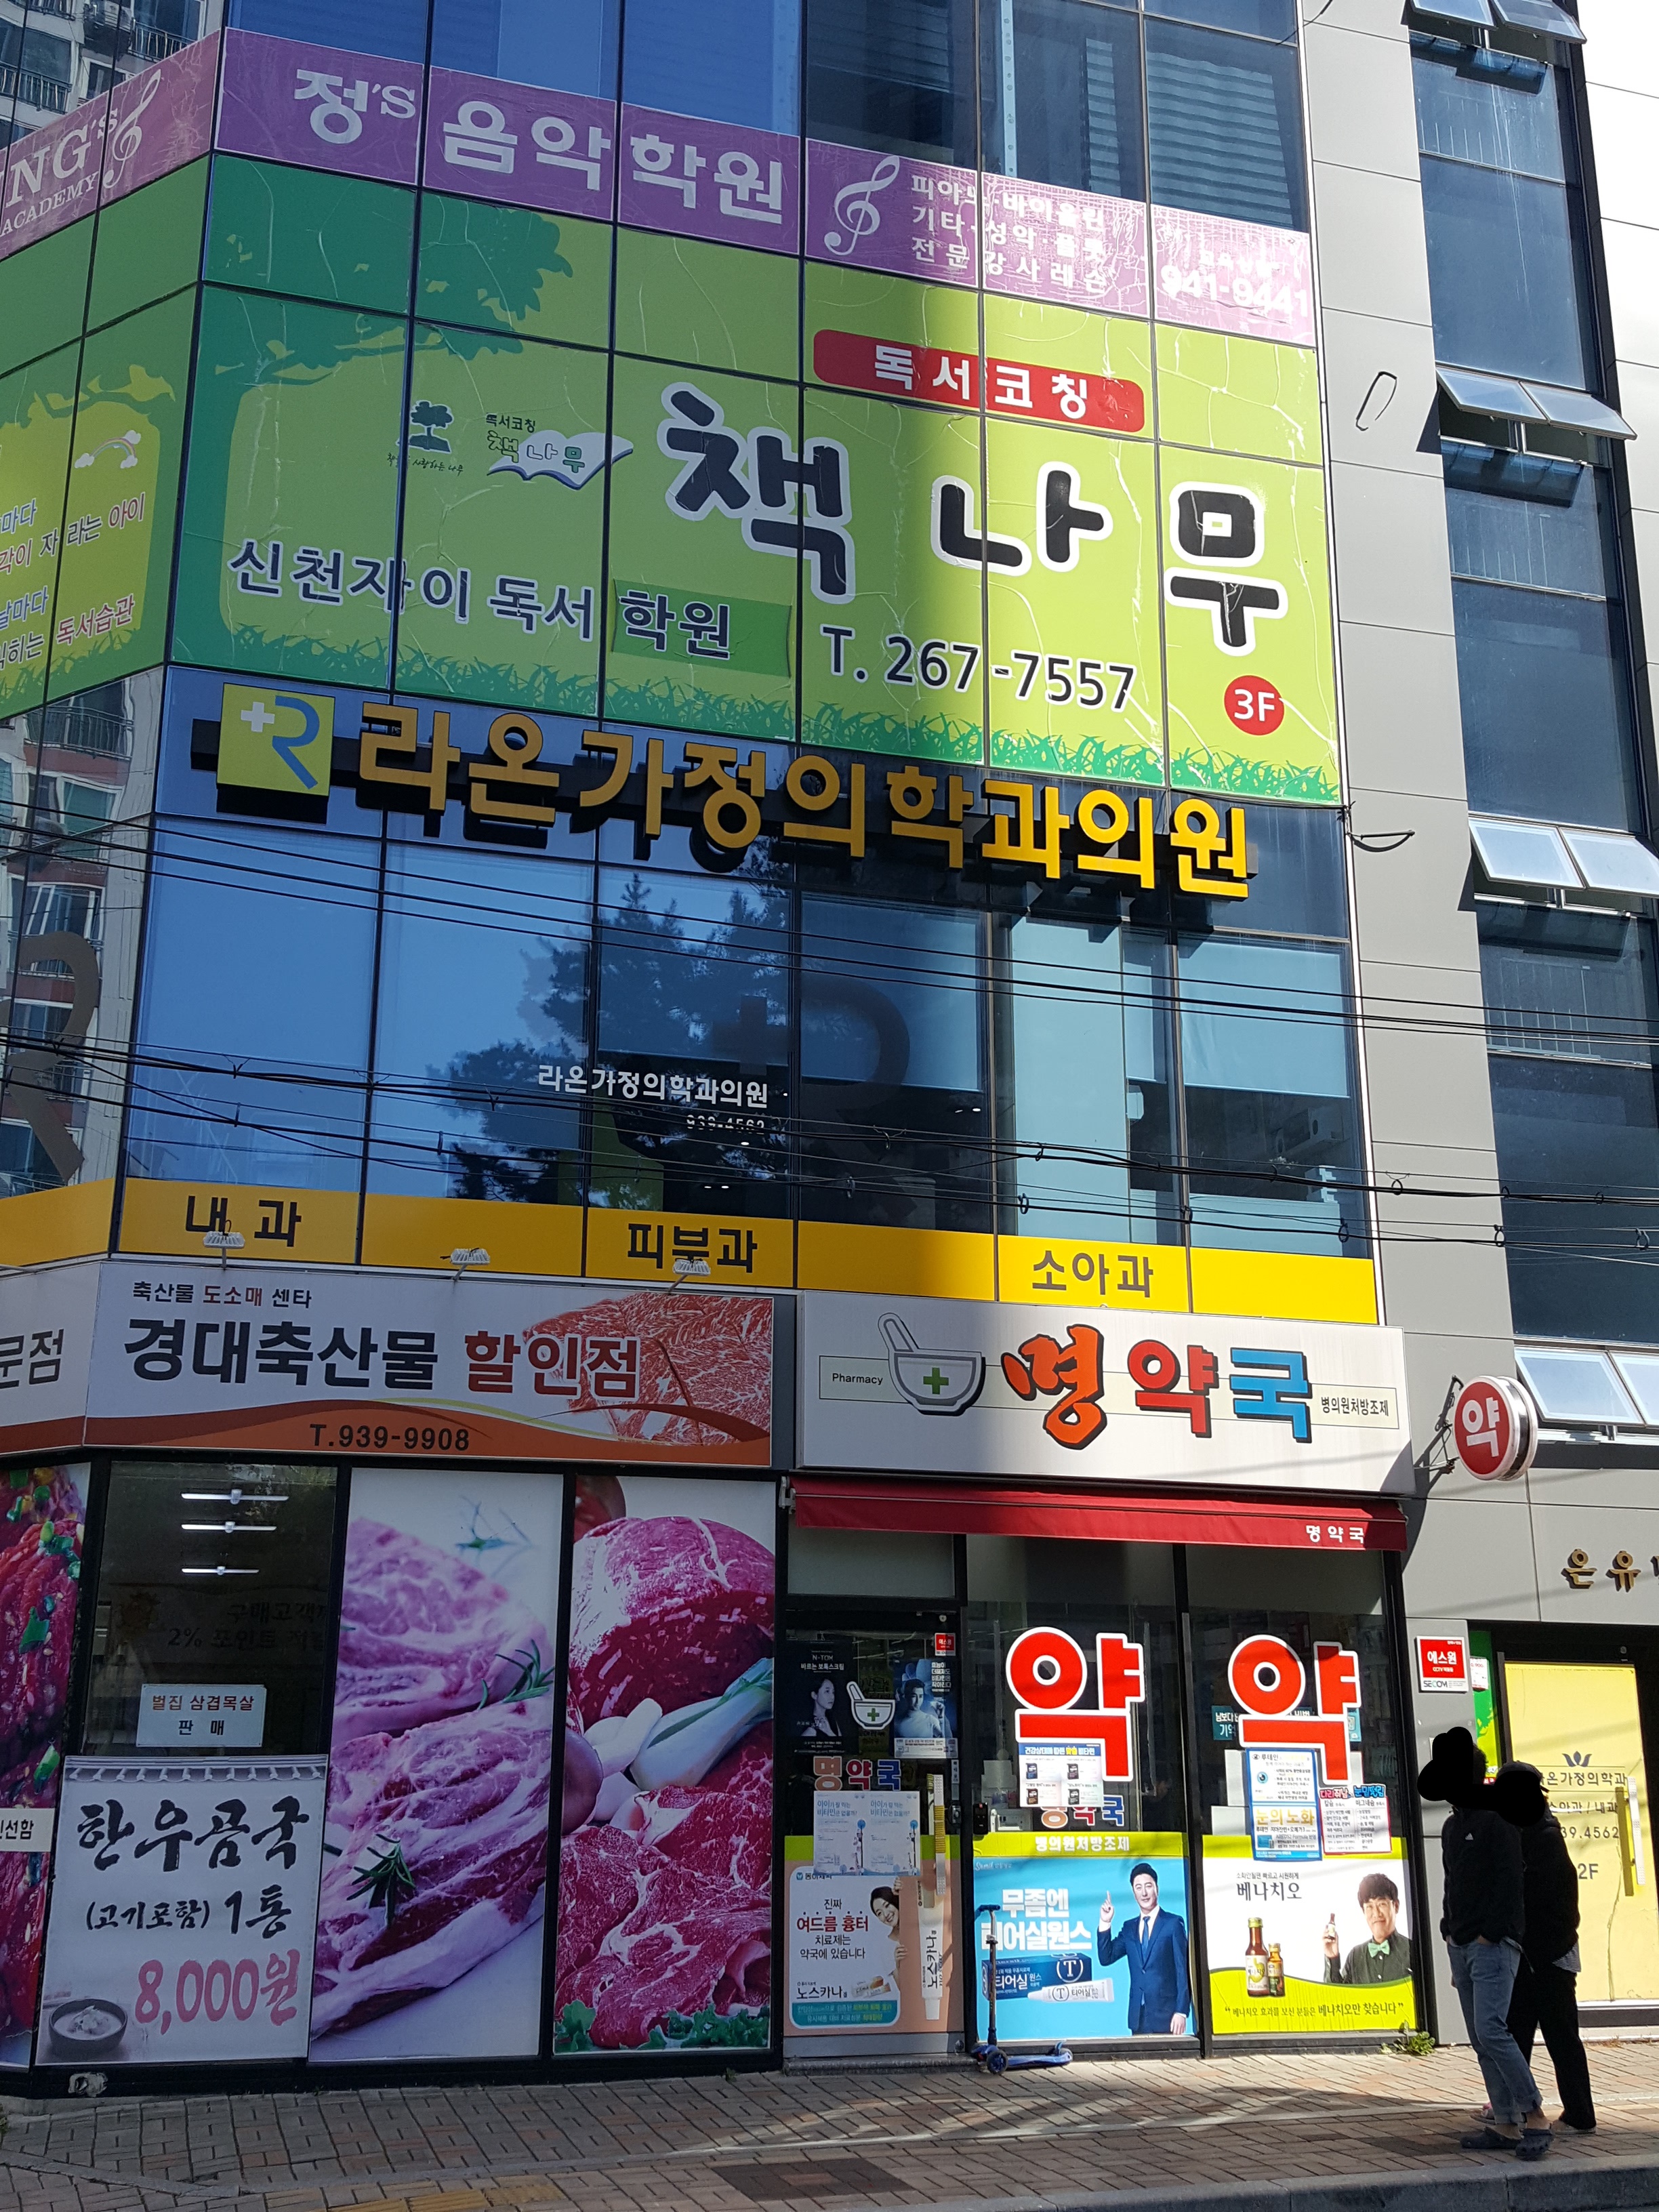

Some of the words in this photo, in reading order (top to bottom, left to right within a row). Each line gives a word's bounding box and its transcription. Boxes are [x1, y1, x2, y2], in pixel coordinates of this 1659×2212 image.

[443, 100, 783, 224] 음악학원
[0, 170, 99, 238] ACADEMY
[1161, 264, 1308, 317] 941-9441
[875, 344, 1088, 420] 독서코칭
[448, 464, 464, 476] 나무
[487, 430, 585, 474] 책나무
[0, 498, 37, 533] 마다
[108, 492, 145, 529] 아이
[661, 386, 1285, 652] 책나무
[228, 540, 472, 623] 신천자이
[487, 575, 594, 640] 독서
[619, 589, 731, 661] 학원
[56, 594, 135, 645] 독서습관
[885, 635, 1136, 711] 267-7557
[1233, 687, 1275, 720] 3F
[359, 701, 1249, 898] 라온가정의학과의원
[538, 1065, 768, 1109] 라온가정의학과의원
[186, 1195, 302, 1247] 내과
[628, 1223, 757, 1273] 피부과
[1032, 1249, 1153, 1298] 소아과
[132, 1282, 194, 1303] 축산물
[203, 1286, 262, 1307] 도소매
[272, 1289, 312, 1308] 센타
[125, 1319, 437, 1390] 경대축산물
[465, 1330, 638, 1398] 할인점
[832, 1372, 884, 1387] Pharmacy
[1321, 1396, 1389, 1417] 병의원처방조제
[1462, 1397, 1500, 1458] 약
[1306, 1525, 1364, 1544] 명약국
[1427, 1651, 1457, 1665] 에스원
[152, 1696, 182, 1711] 벌집
[189, 1695, 255, 1712] 삼겹목살
[1007, 1628, 1144, 1780] 약
[1229, 1636, 1360, 1784] 약
[178, 1719, 224, 1736] 판매
[814, 1756, 901, 1792] 명약국
[1540, 1771, 1627, 1786] 온가정의학과
[77, 1796, 310, 1872] 한우곰국
[1256, 1809, 1283, 1825] 눈의
[1286, 1809, 1315, 1826] 노화
[1577, 1863, 1599, 1880] 2F
[824, 1898, 842, 1910] 진짜
[1002, 1889, 1069, 1918] 무좀엔
[1237, 1882, 1302, 1901] 베나치오
[86, 1900, 210, 1931] (고기포함)
[224, 1885, 292, 1939] 1통
[797, 1916, 838, 1932] 여드름
[842, 1915, 868, 1932] 흉터
[800, 1949, 827, 1960] 약국에
[831, 1947, 865, 1959] 있습니다
[815, 1935, 851, 1946] 치료제는
[981, 1921, 1092, 1951] 티어실원스
[927, 1936, 937, 1988] 노스카나
[135, 1948, 301, 2035] 8,000원
[796, 1986, 843, 1999] 노스카나
[1318, 2003, 1360, 2017] 베나치오만
